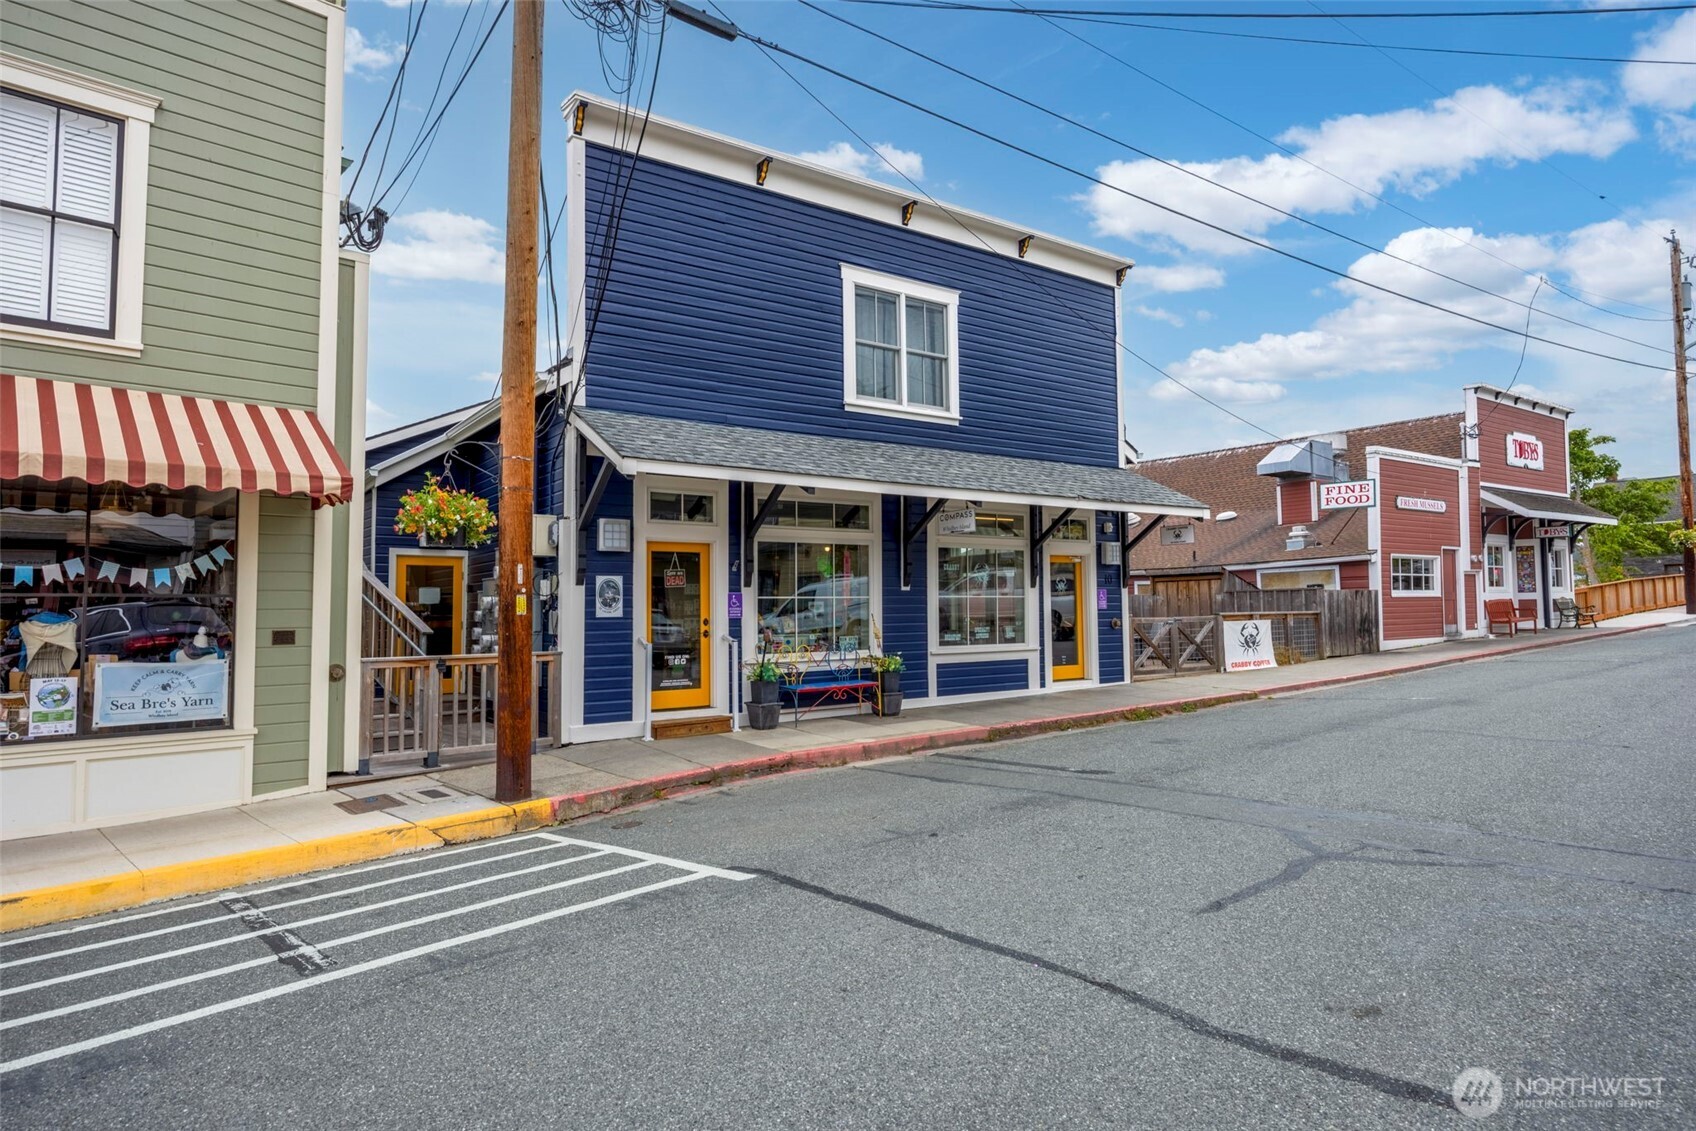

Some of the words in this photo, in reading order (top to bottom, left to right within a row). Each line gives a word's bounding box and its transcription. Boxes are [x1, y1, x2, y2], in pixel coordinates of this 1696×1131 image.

[1325, 483, 1370, 495] FINE
[1325, 494, 1370, 506] FOOD
[1400, 499, 1419, 508] FRESH
[1419, 500, 1444, 511] MUSSELS
[939, 510, 973, 522] COMPASS
[666, 576, 684, 586] DEAD
[130, 678, 141, 692] KEEP
[141, 669, 159, 680] CALM
[167, 669, 185, 678] CARRY
[185, 676, 197, 689] YARN
[110, 699, 136, 711] Sea
[140, 697, 177, 709] Bre's
[181, 696, 214, 707] Yarn
